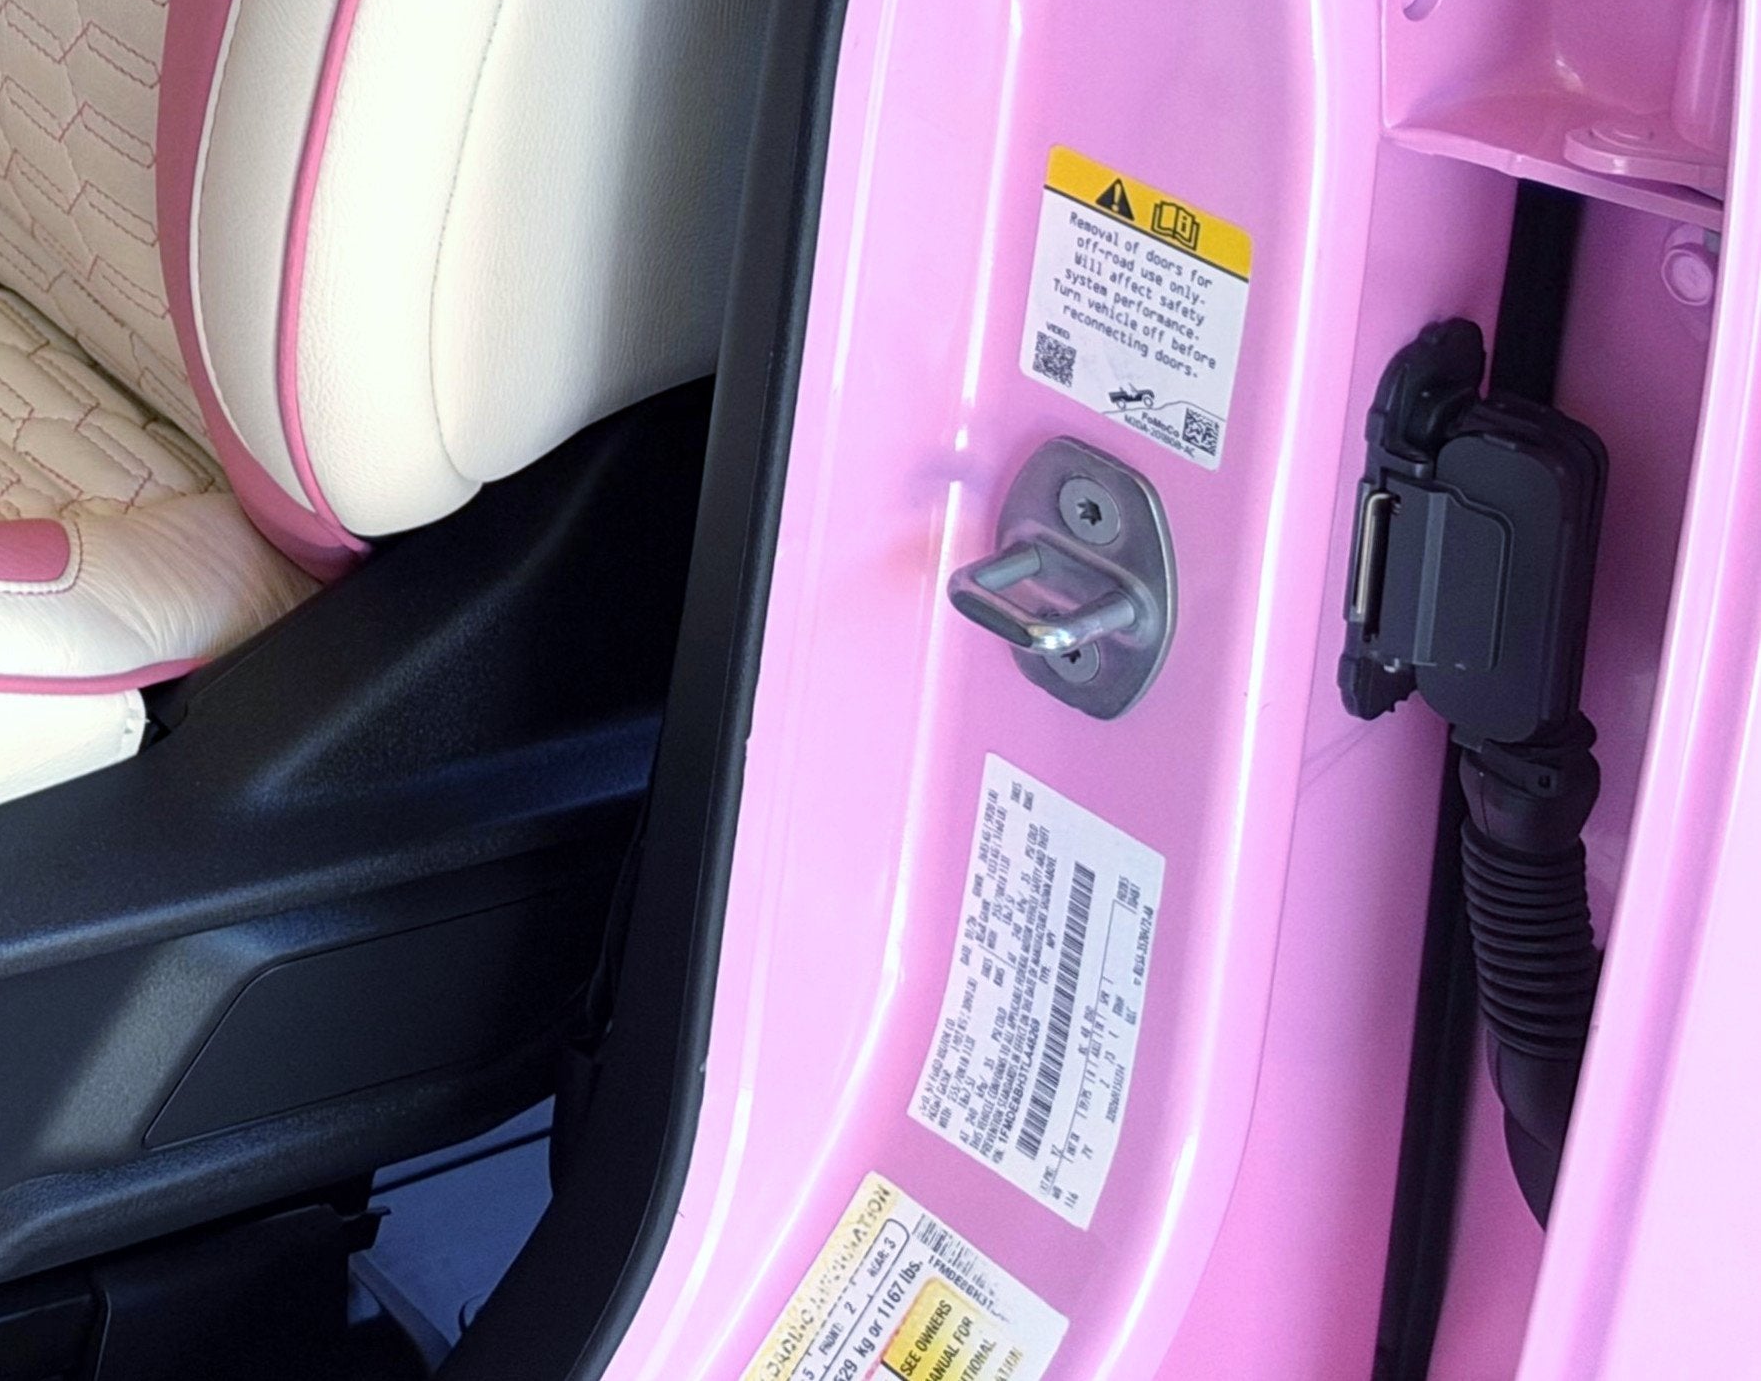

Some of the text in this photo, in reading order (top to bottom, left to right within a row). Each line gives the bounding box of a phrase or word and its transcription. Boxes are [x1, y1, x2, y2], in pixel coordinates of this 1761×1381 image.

[1070, 212, 1213, 288] Removal of doors for
[1077, 237, 1134, 272] off-road
[1141, 268, 1163, 286] use
[1053, 278, 1216, 369] Turn vehicle off before
[1065, 268, 1199, 340] system performance.
[1074, 252, 1205, 327] Will affect safety
[1047, 323, 1070, 340] VIDEO
[1063, 305, 1197, 378] reconnecting doors.
[1141, 412, 1179, 438] FoMoCo
[844, 1301, 856, 1314] 2
[883, 1237, 896, 1250] 3
[853, 1337, 875, 1358] kg
[868, 1319, 883, 1338] or
[877, 1280, 904, 1318] 1167
[899, 1261, 922, 1284] lbs.
[900, 1300, 951, 1376] SEE OWNERS
[952, 1316, 972, 1344] FOR
